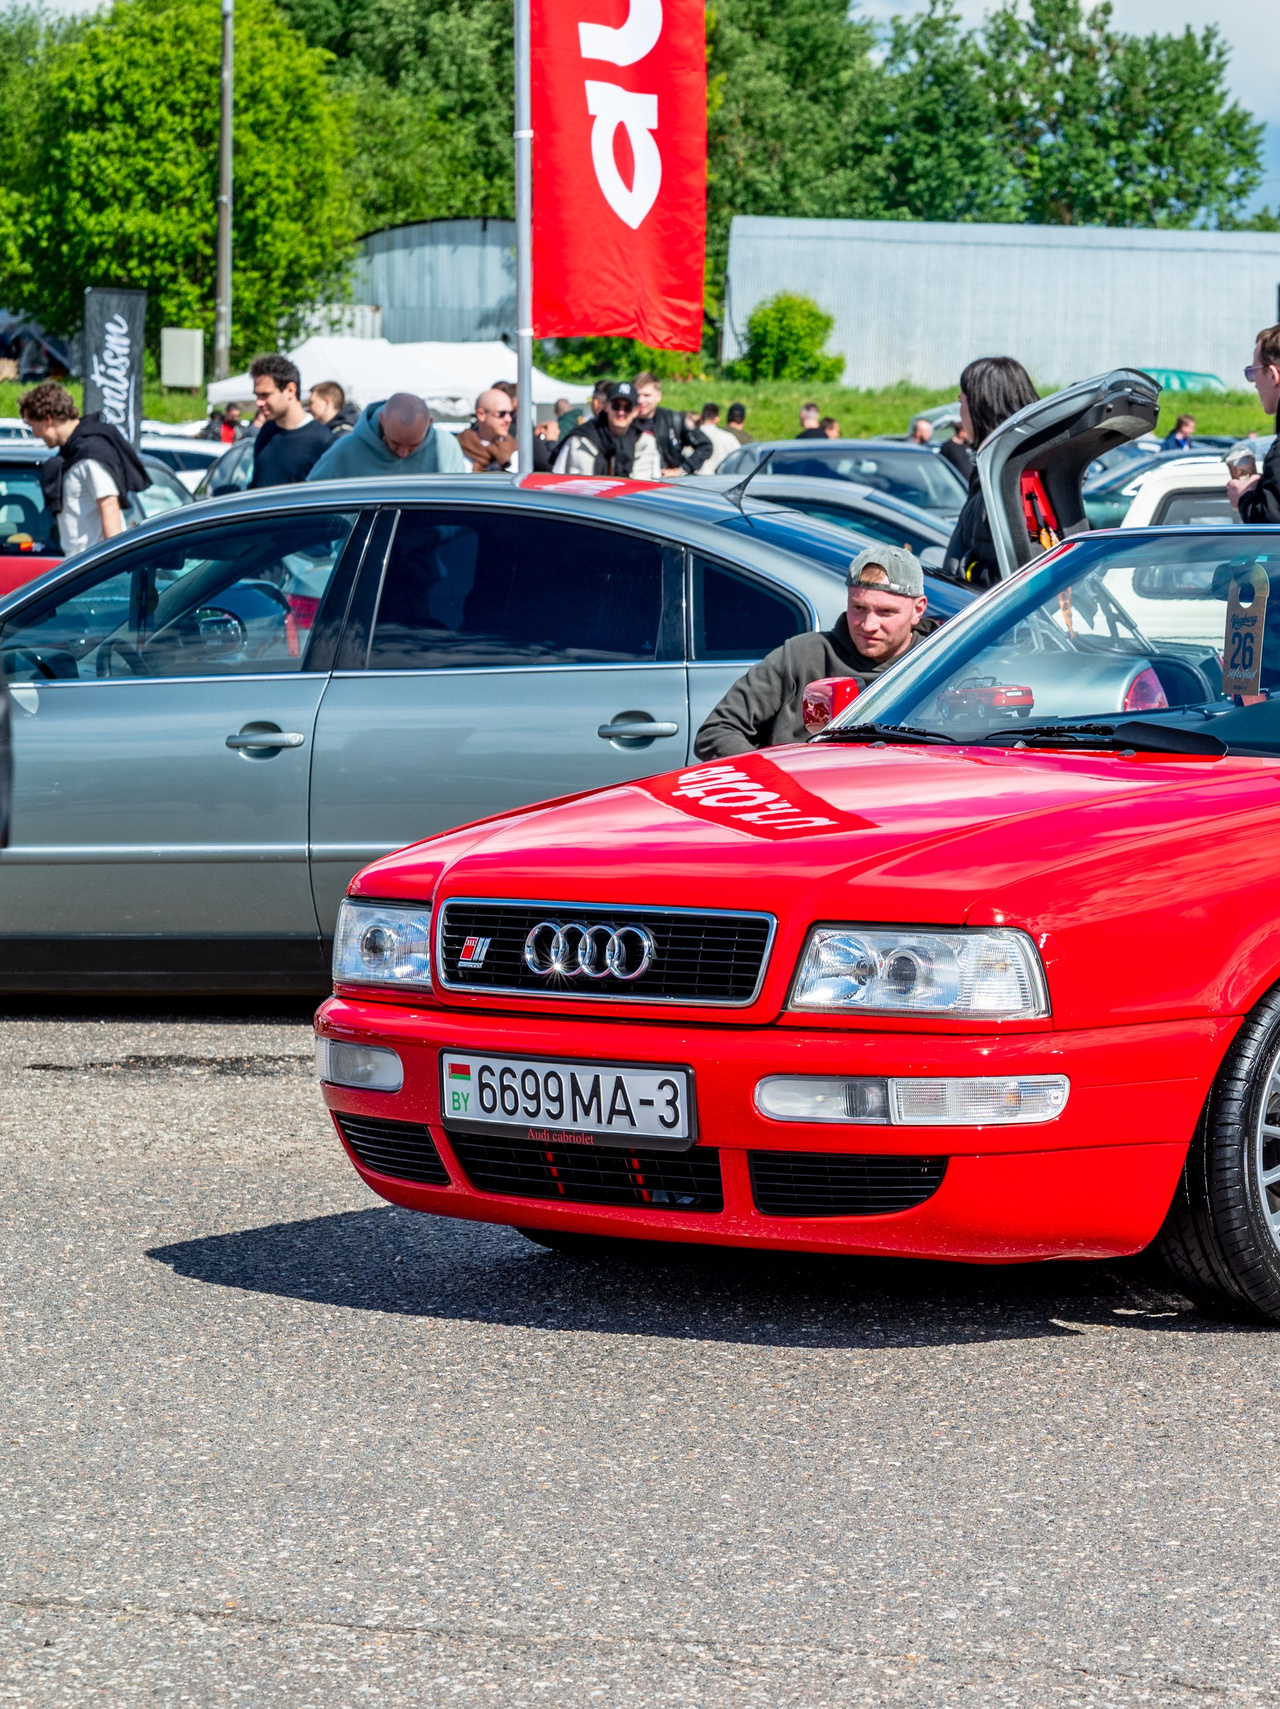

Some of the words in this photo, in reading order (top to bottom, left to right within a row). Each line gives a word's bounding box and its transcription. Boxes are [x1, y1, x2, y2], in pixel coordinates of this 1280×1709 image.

[1230, 631, 1255, 670] 26
[451, 1091, 470, 1113] BY
[477, 1064, 681, 1130] 6699MA-3
[527, 1128, 550, 1141] Audi
[552, 1131, 594, 1145] cabriolet
